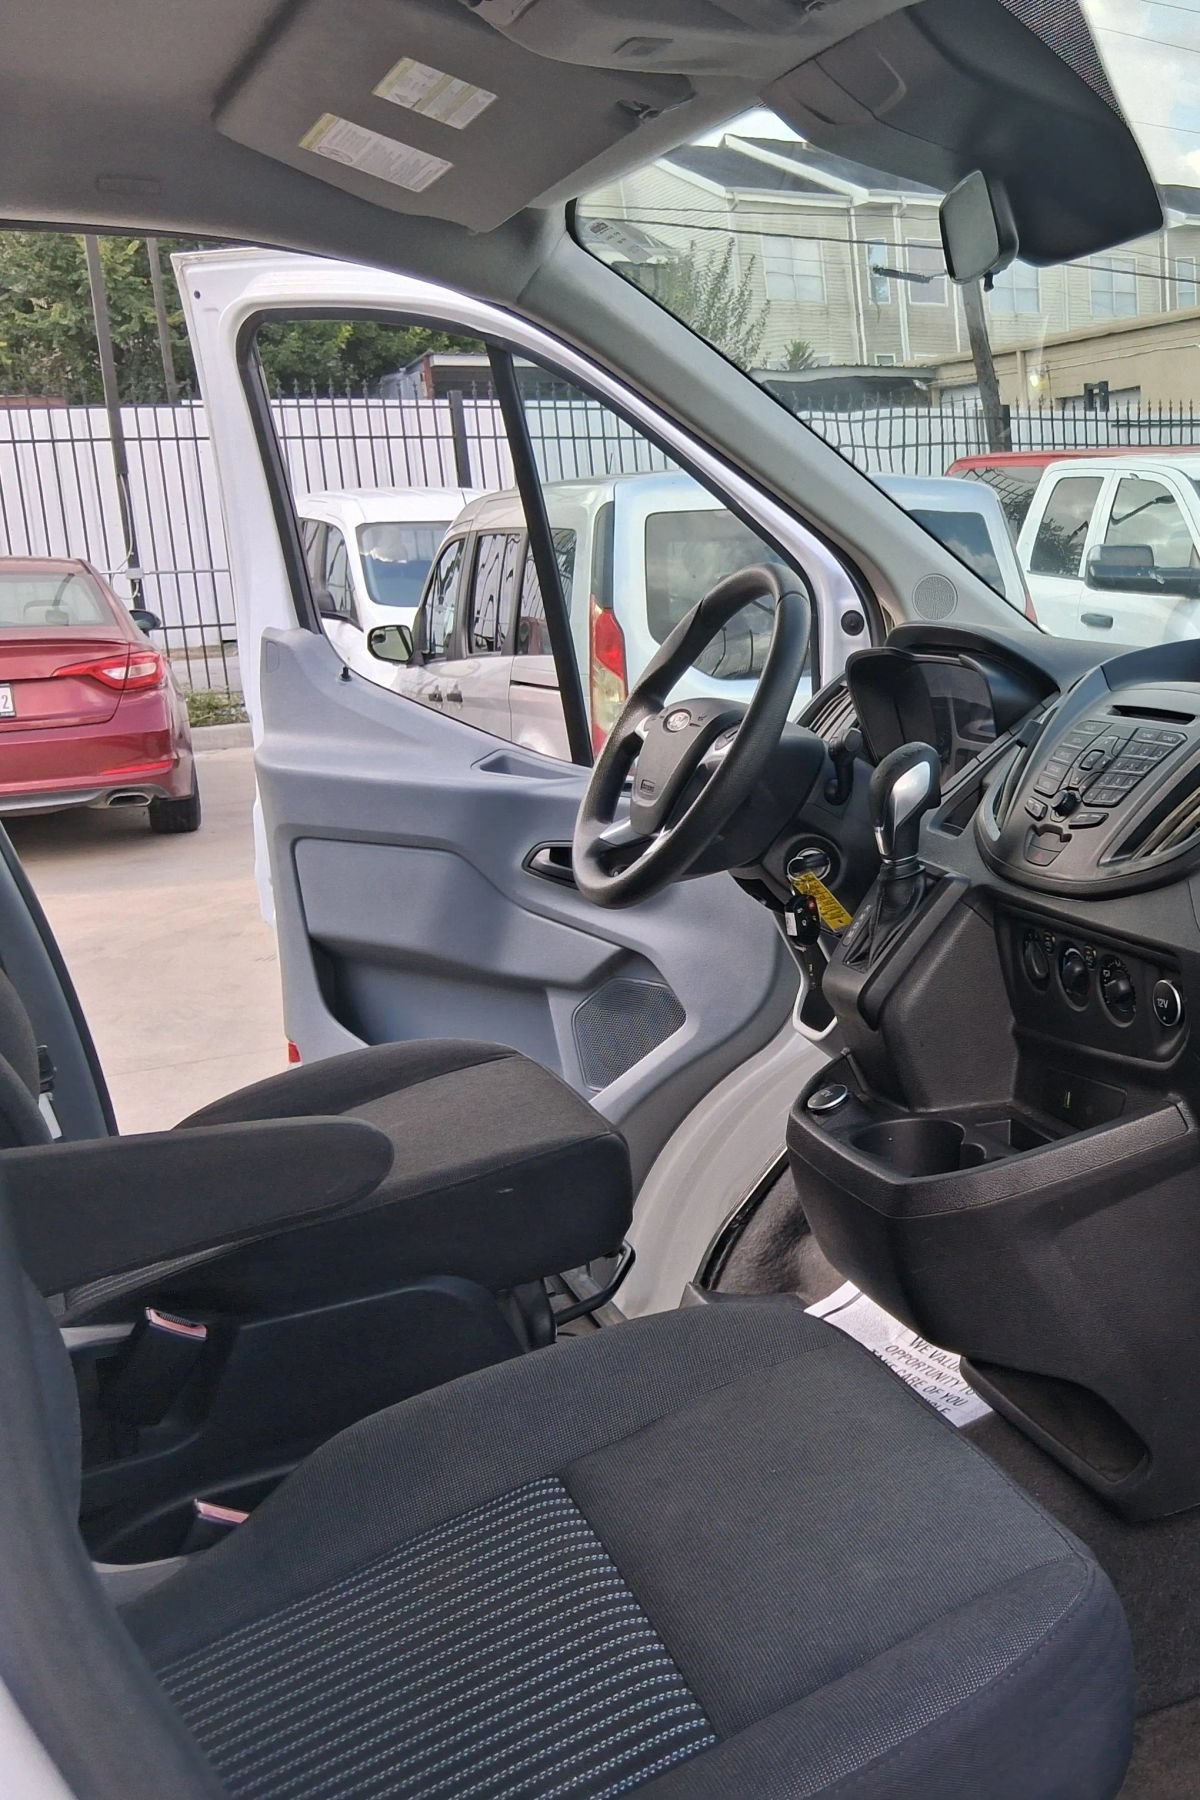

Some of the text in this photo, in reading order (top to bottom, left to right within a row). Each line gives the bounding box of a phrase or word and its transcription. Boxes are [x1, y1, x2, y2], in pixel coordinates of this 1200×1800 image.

[1156, 997, 1169, 1009] 12V
[909, 1336, 933, 1354] WE
[884, 1344, 965, 1388] OPPORTUNITY
[896, 1369, 929, 1388] CARE
[922, 1385, 944, 1395] OF
[939, 1392, 969, 1407] YOU
